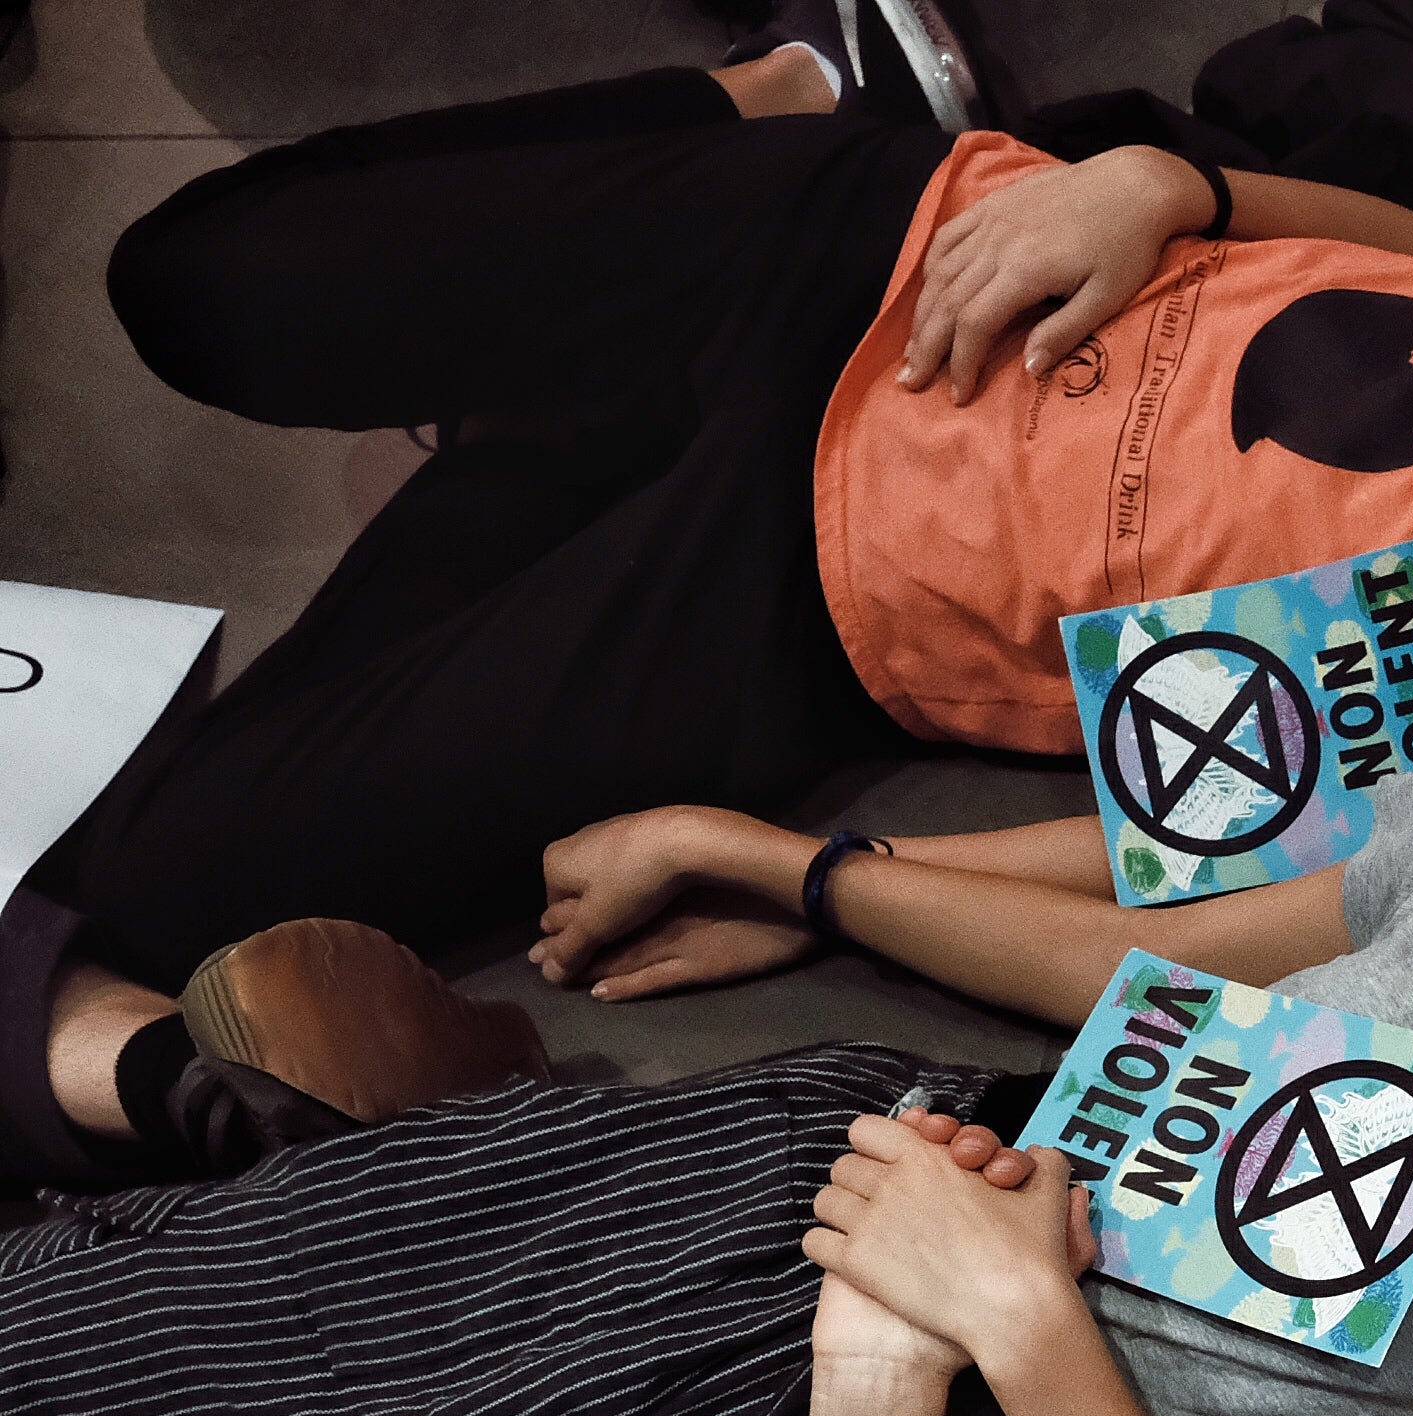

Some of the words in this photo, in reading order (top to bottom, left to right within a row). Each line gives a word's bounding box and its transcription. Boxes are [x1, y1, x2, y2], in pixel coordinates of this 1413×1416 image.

[1116, 473, 1143, 540] Drink
[1316, 640, 1398, 791] NON
[1120, 1054, 1251, 1207] NON
